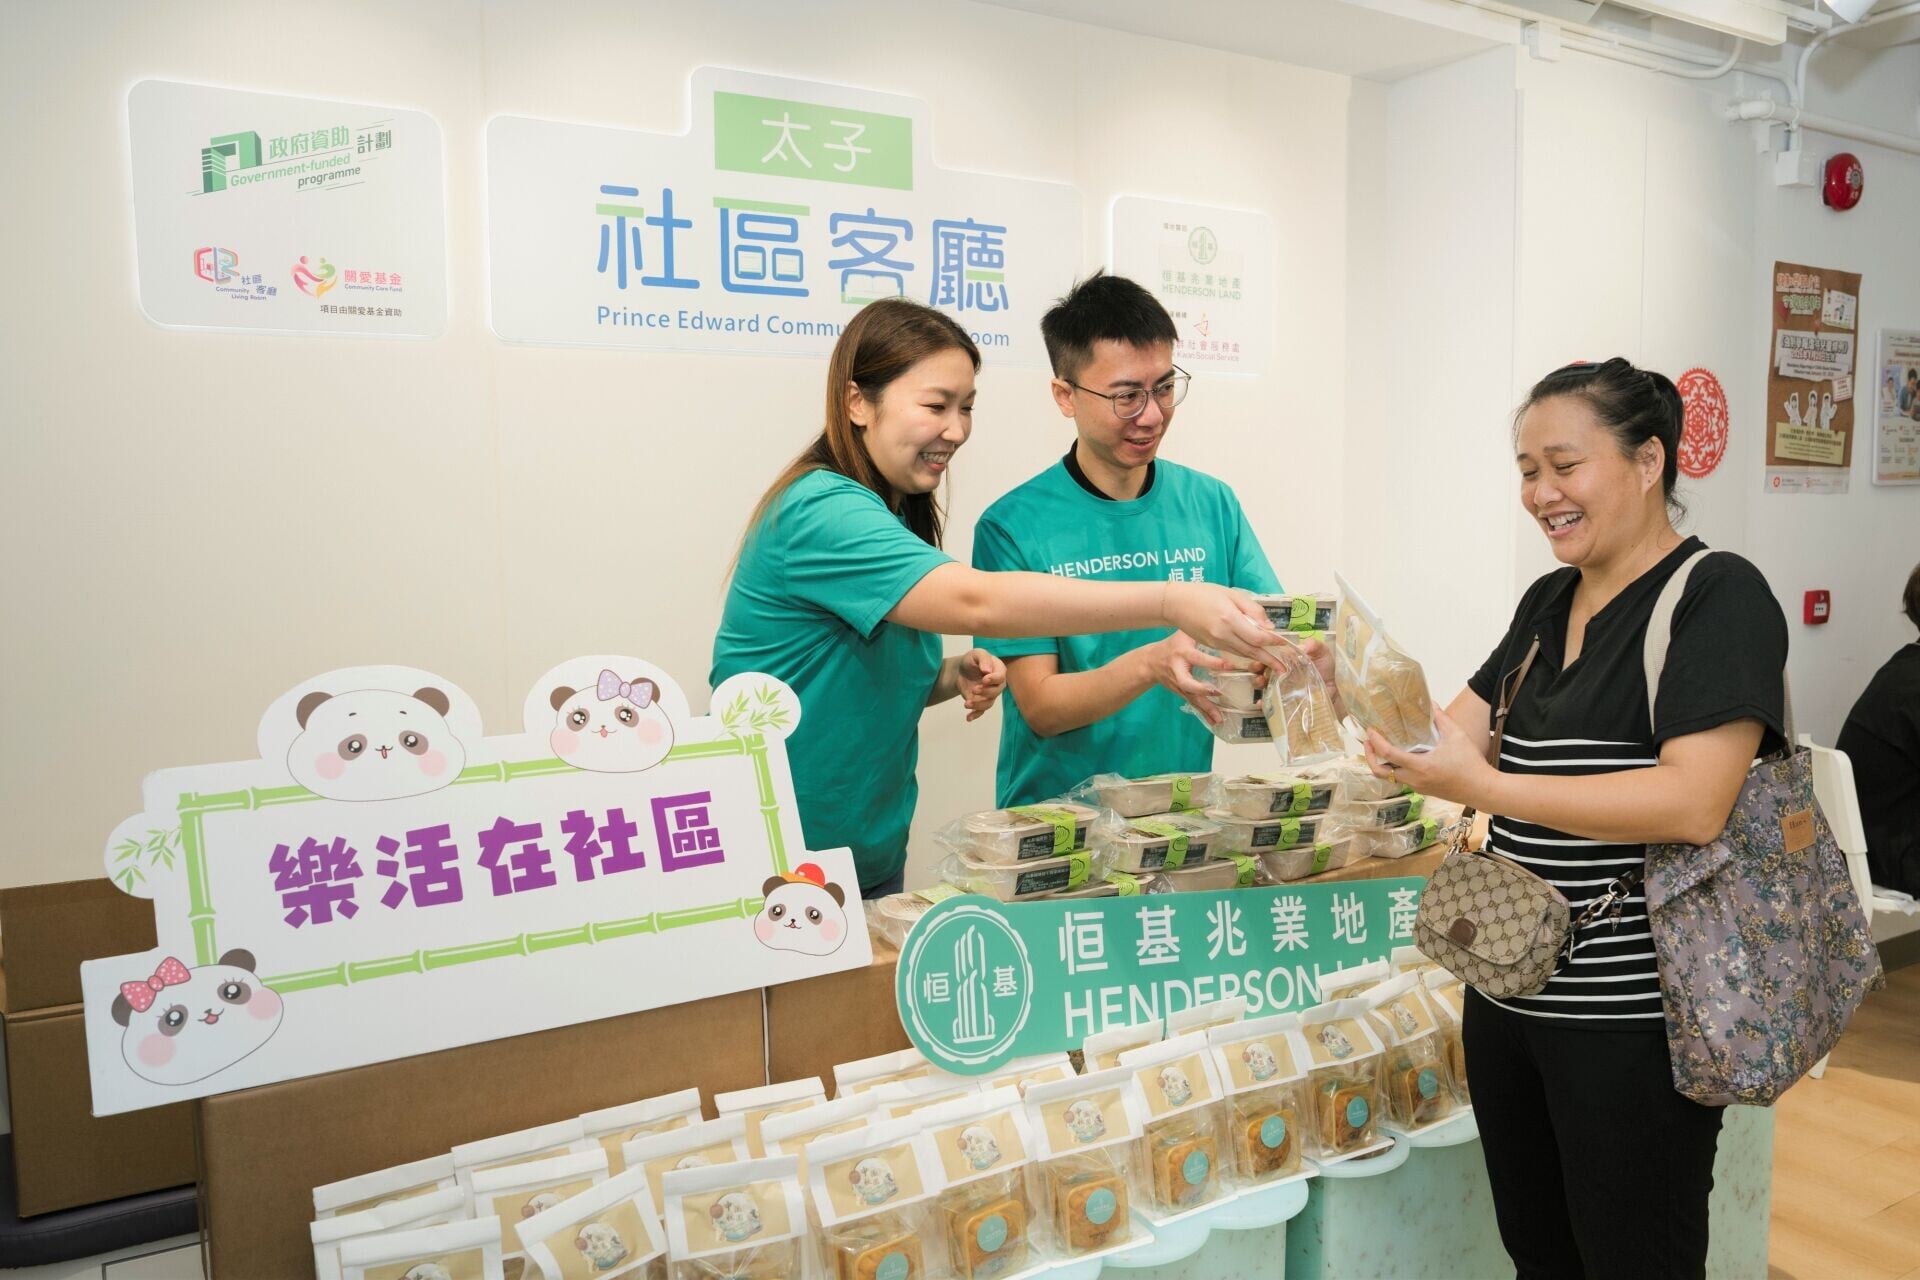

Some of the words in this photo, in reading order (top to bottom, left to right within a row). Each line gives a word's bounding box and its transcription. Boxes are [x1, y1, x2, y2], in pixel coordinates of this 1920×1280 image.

[269, 125, 349, 160] 政府資助
[357, 129, 392, 154] 計劃
[761, 112, 872, 173] 太子
[230, 153, 350, 187] Government-funded
[298, 167, 361, 189] programme
[595, 185, 1011, 312] 社區客廳
[241, 273, 262, 285] 社區
[344, 269, 402, 286] 關愛基金
[344, 283, 375, 292] Community
[216, 286, 250, 295] Community
[256, 284, 277, 297] 客廳
[1162, 284, 1216, 298] HENDERSON
[1218, 290, 1242, 301] LAND
[320, 304, 403, 317] 項目由關愛基金資助
[597, 305, 671, 328] Prince
[678, 310, 760, 333] Edward
[1050, 551, 1160, 577] HENDERSON
[1164, 547, 1207, 564] LAND
[269, 790, 725, 929] 樂活在社區
[1058, 886, 1419, 976] 恒基兆業地產
